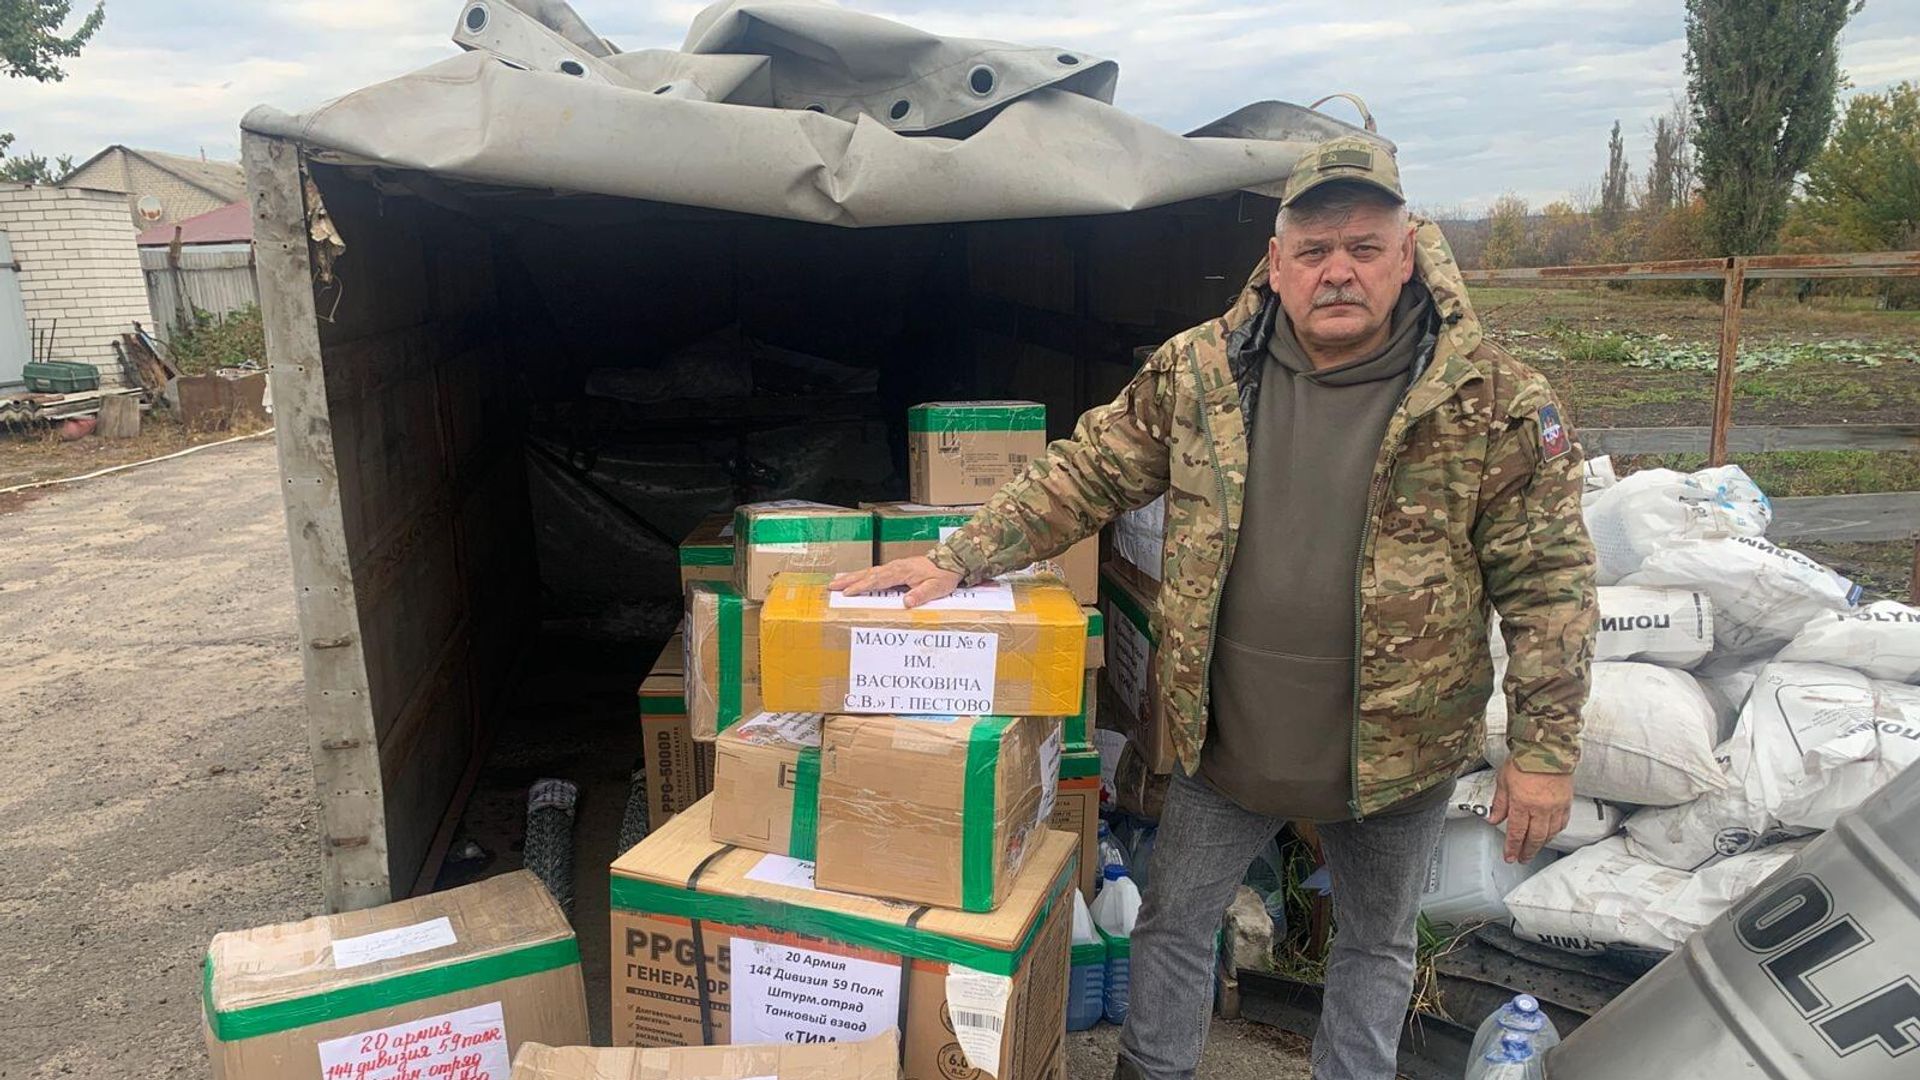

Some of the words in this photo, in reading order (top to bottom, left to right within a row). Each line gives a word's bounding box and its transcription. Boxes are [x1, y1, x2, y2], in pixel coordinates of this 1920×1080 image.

[856, 631, 909, 647] МАОУ
[913, 633, 951, 649] «СШ
[954, 636, 974, 649] №
[976, 636, 987, 649] 6
[903, 655, 935, 670] ИМ.
[855, 674, 982, 692] ВАСЮКОВИЧА
[844, 693, 885, 710] С.В.»
[890, 695, 906, 710] Г.
[908, 696, 991, 713] ПЕСТОВО
[785, 951, 801, 963] 20
[803, 955, 846, 972] Армия
[1730, 871, 1920, 1059] OLF
[749, 964, 771, 977] 144
[773, 968, 828, 988] Дивизия
[832, 978, 848, 990] 59
[850, 982, 884, 998] Полк
[765, 1004, 827, 1025] Танковый
[830, 1016, 867, 1033] взвод
[360, 1033, 388, 1054] 20
[392, 1021, 453, 1046] армия
[326, 1062, 352, 1078] 144
[356, 1044, 432, 1079] дивизия
